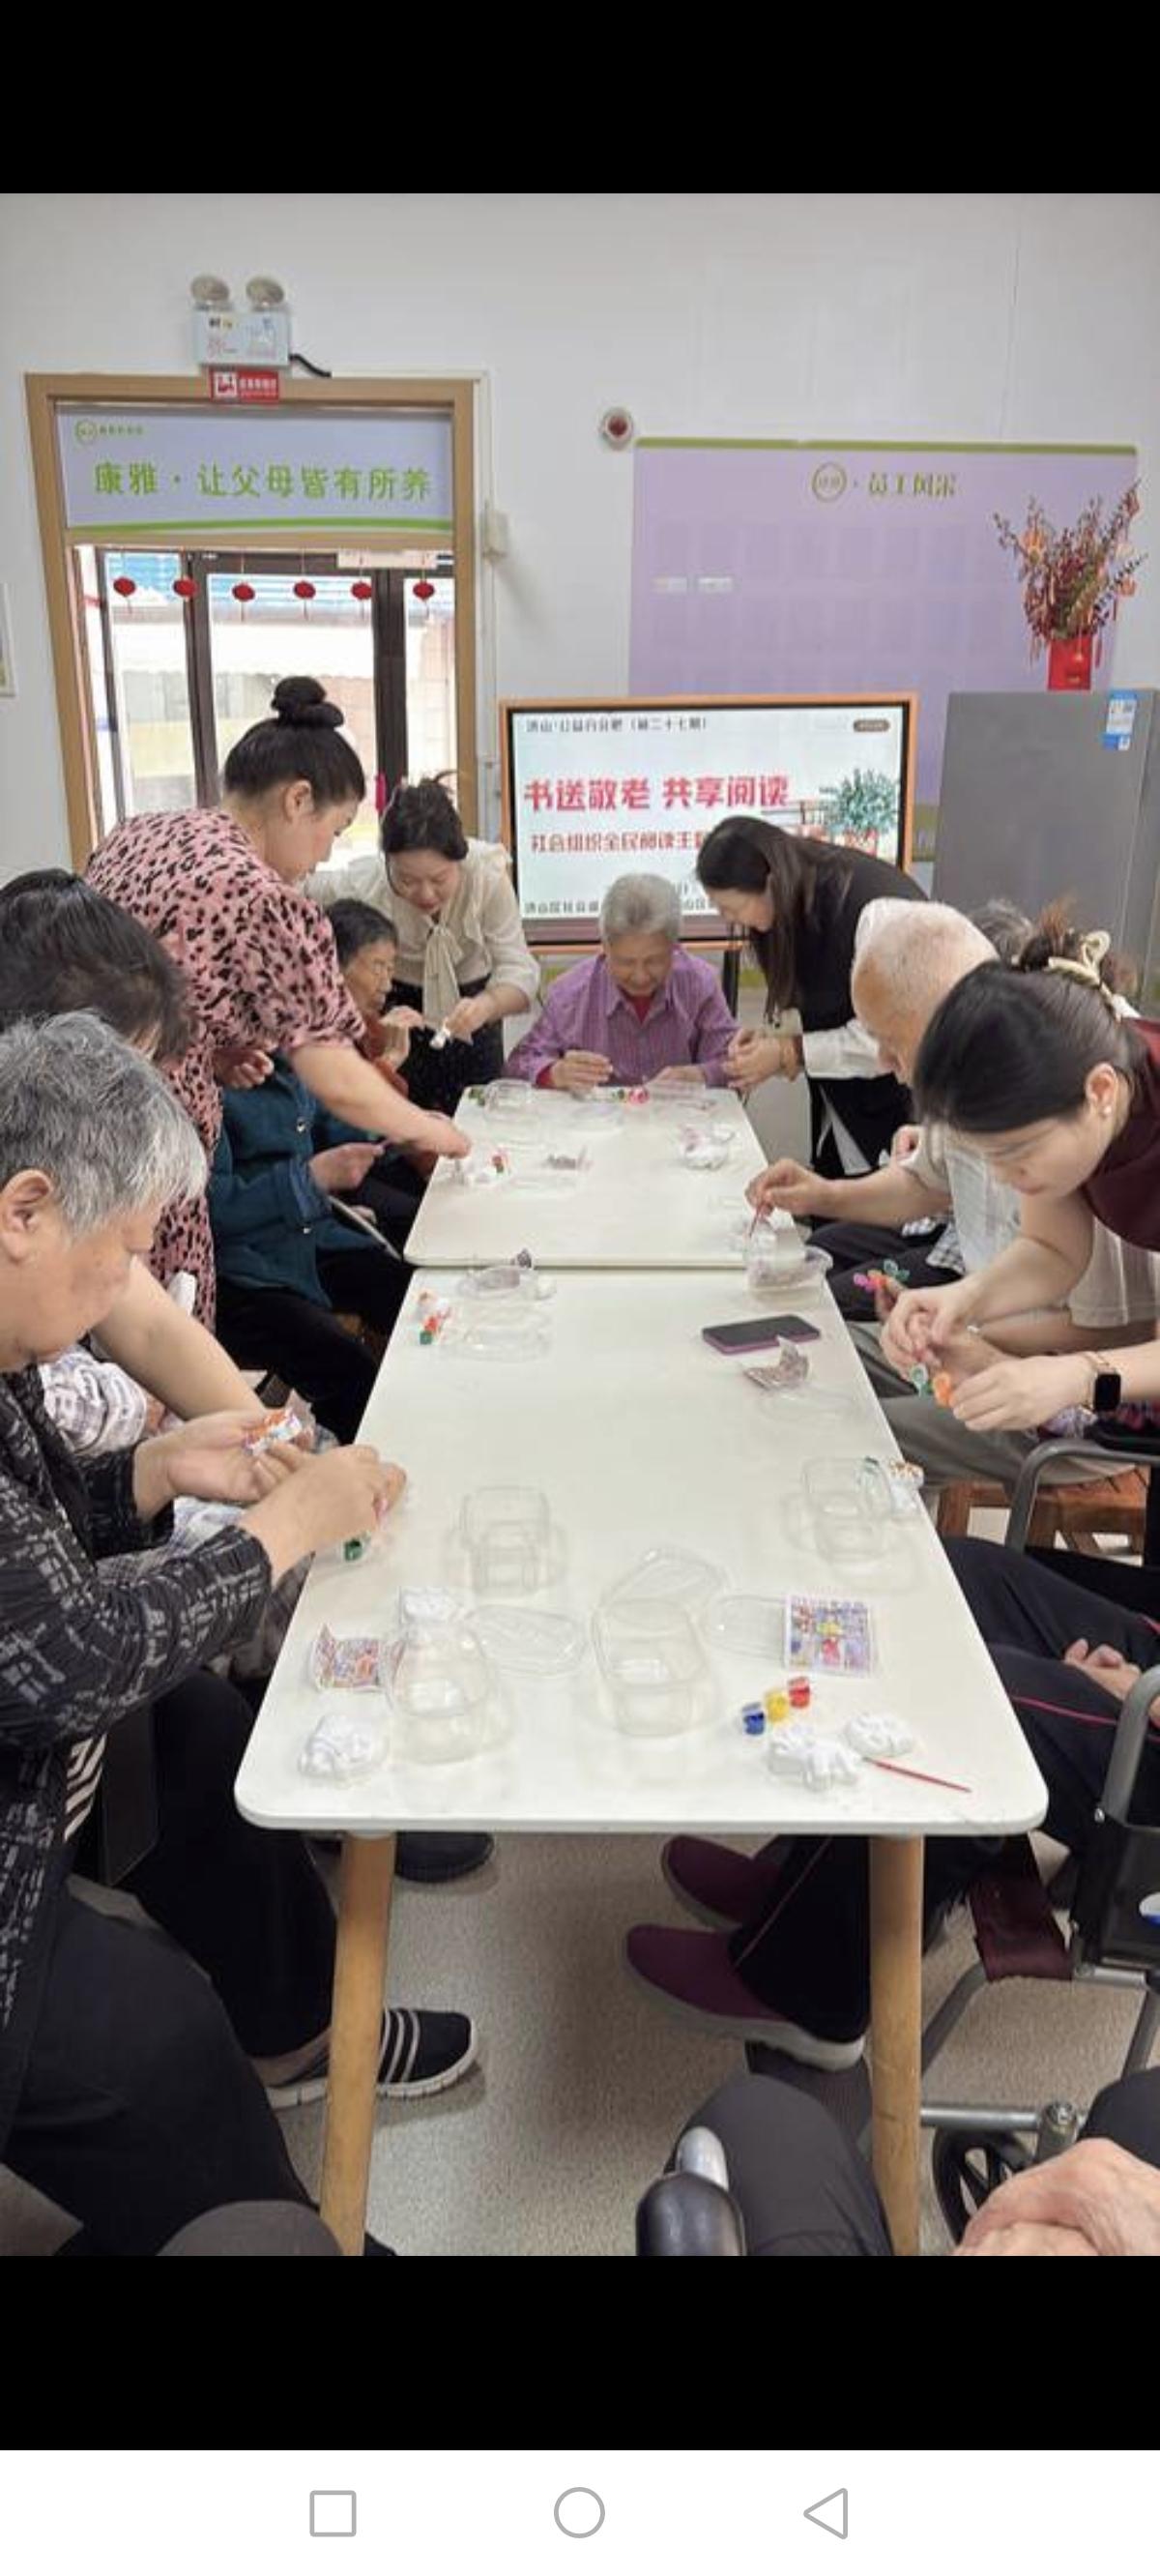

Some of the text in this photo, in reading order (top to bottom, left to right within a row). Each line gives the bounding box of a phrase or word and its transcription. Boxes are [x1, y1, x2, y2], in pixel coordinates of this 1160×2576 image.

[95, 462, 431, 501] 康雅·让父母皆有所养
[524, 775, 789, 811] 书送敬老 共享阅读
